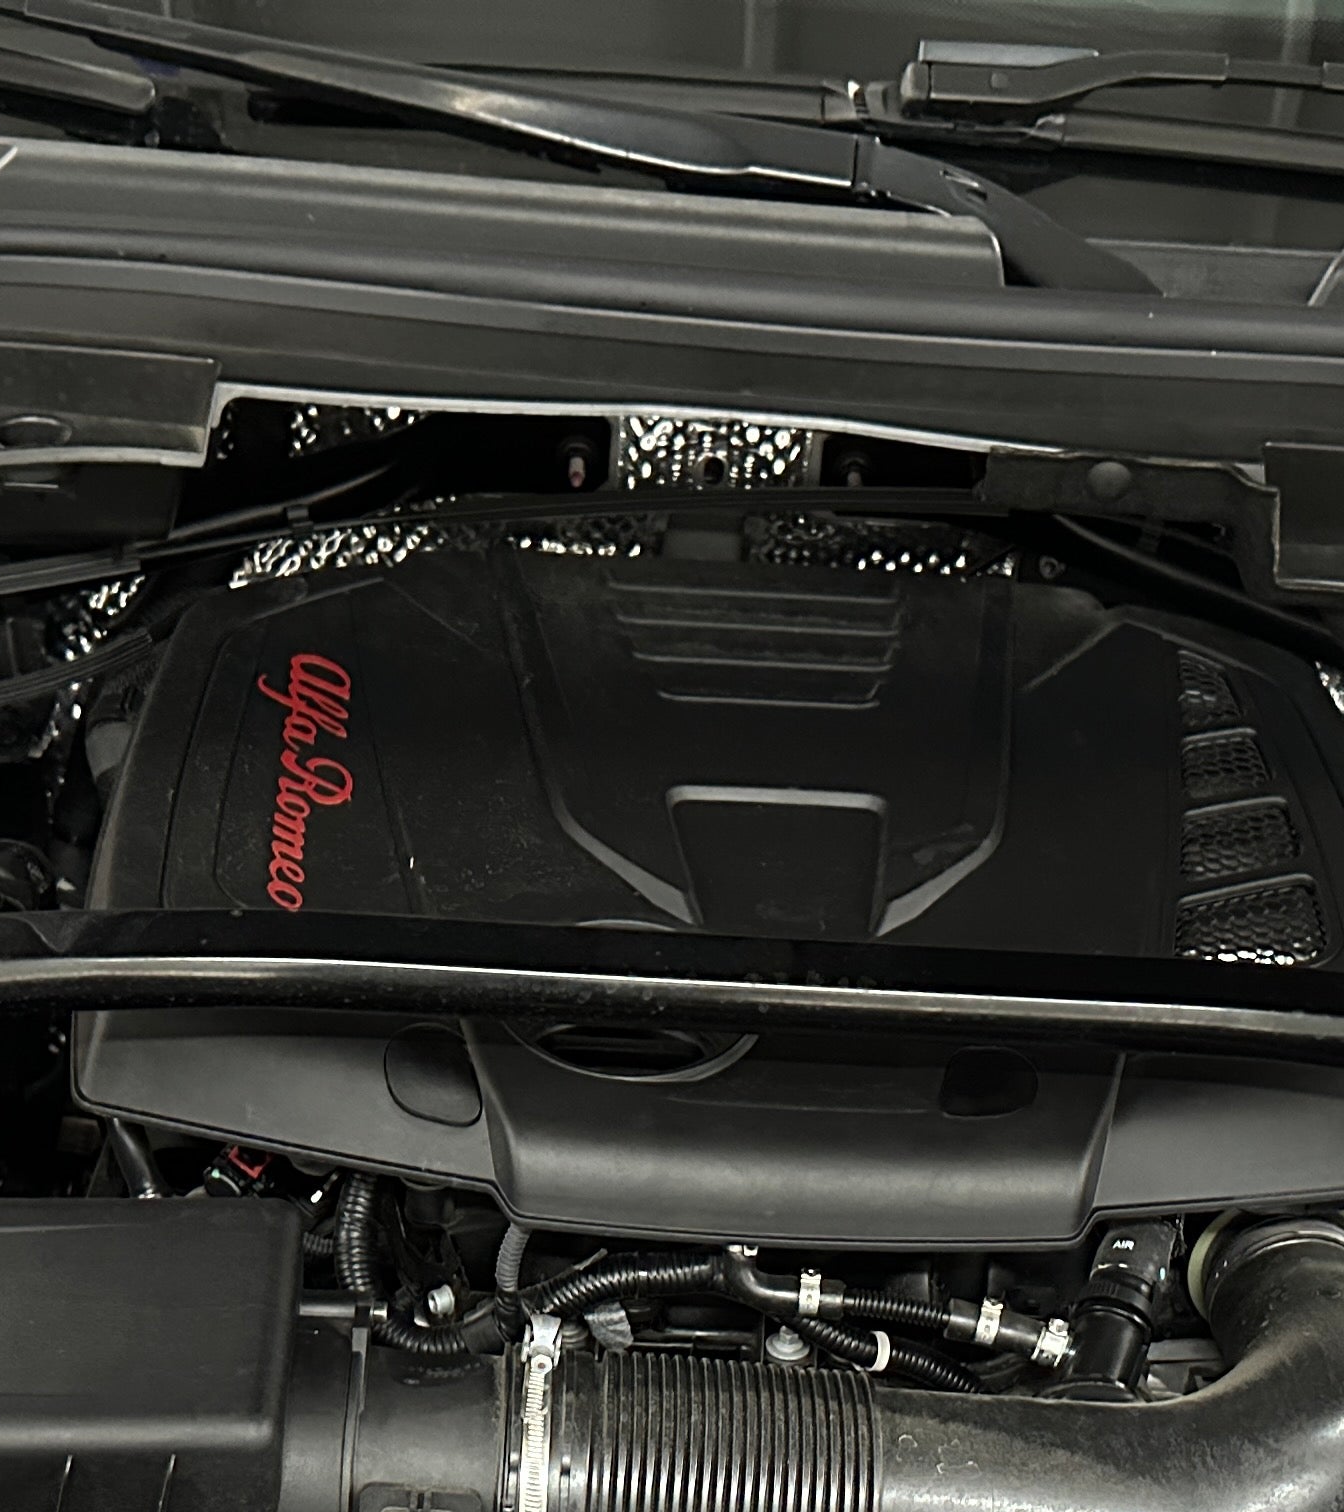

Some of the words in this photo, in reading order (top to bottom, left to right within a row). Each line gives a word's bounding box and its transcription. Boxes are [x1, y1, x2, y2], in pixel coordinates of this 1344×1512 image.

[257, 652, 352, 750] Alfa
[266, 746, 354, 911] Romeo
[1112, 1239, 1135, 1251] AIR
